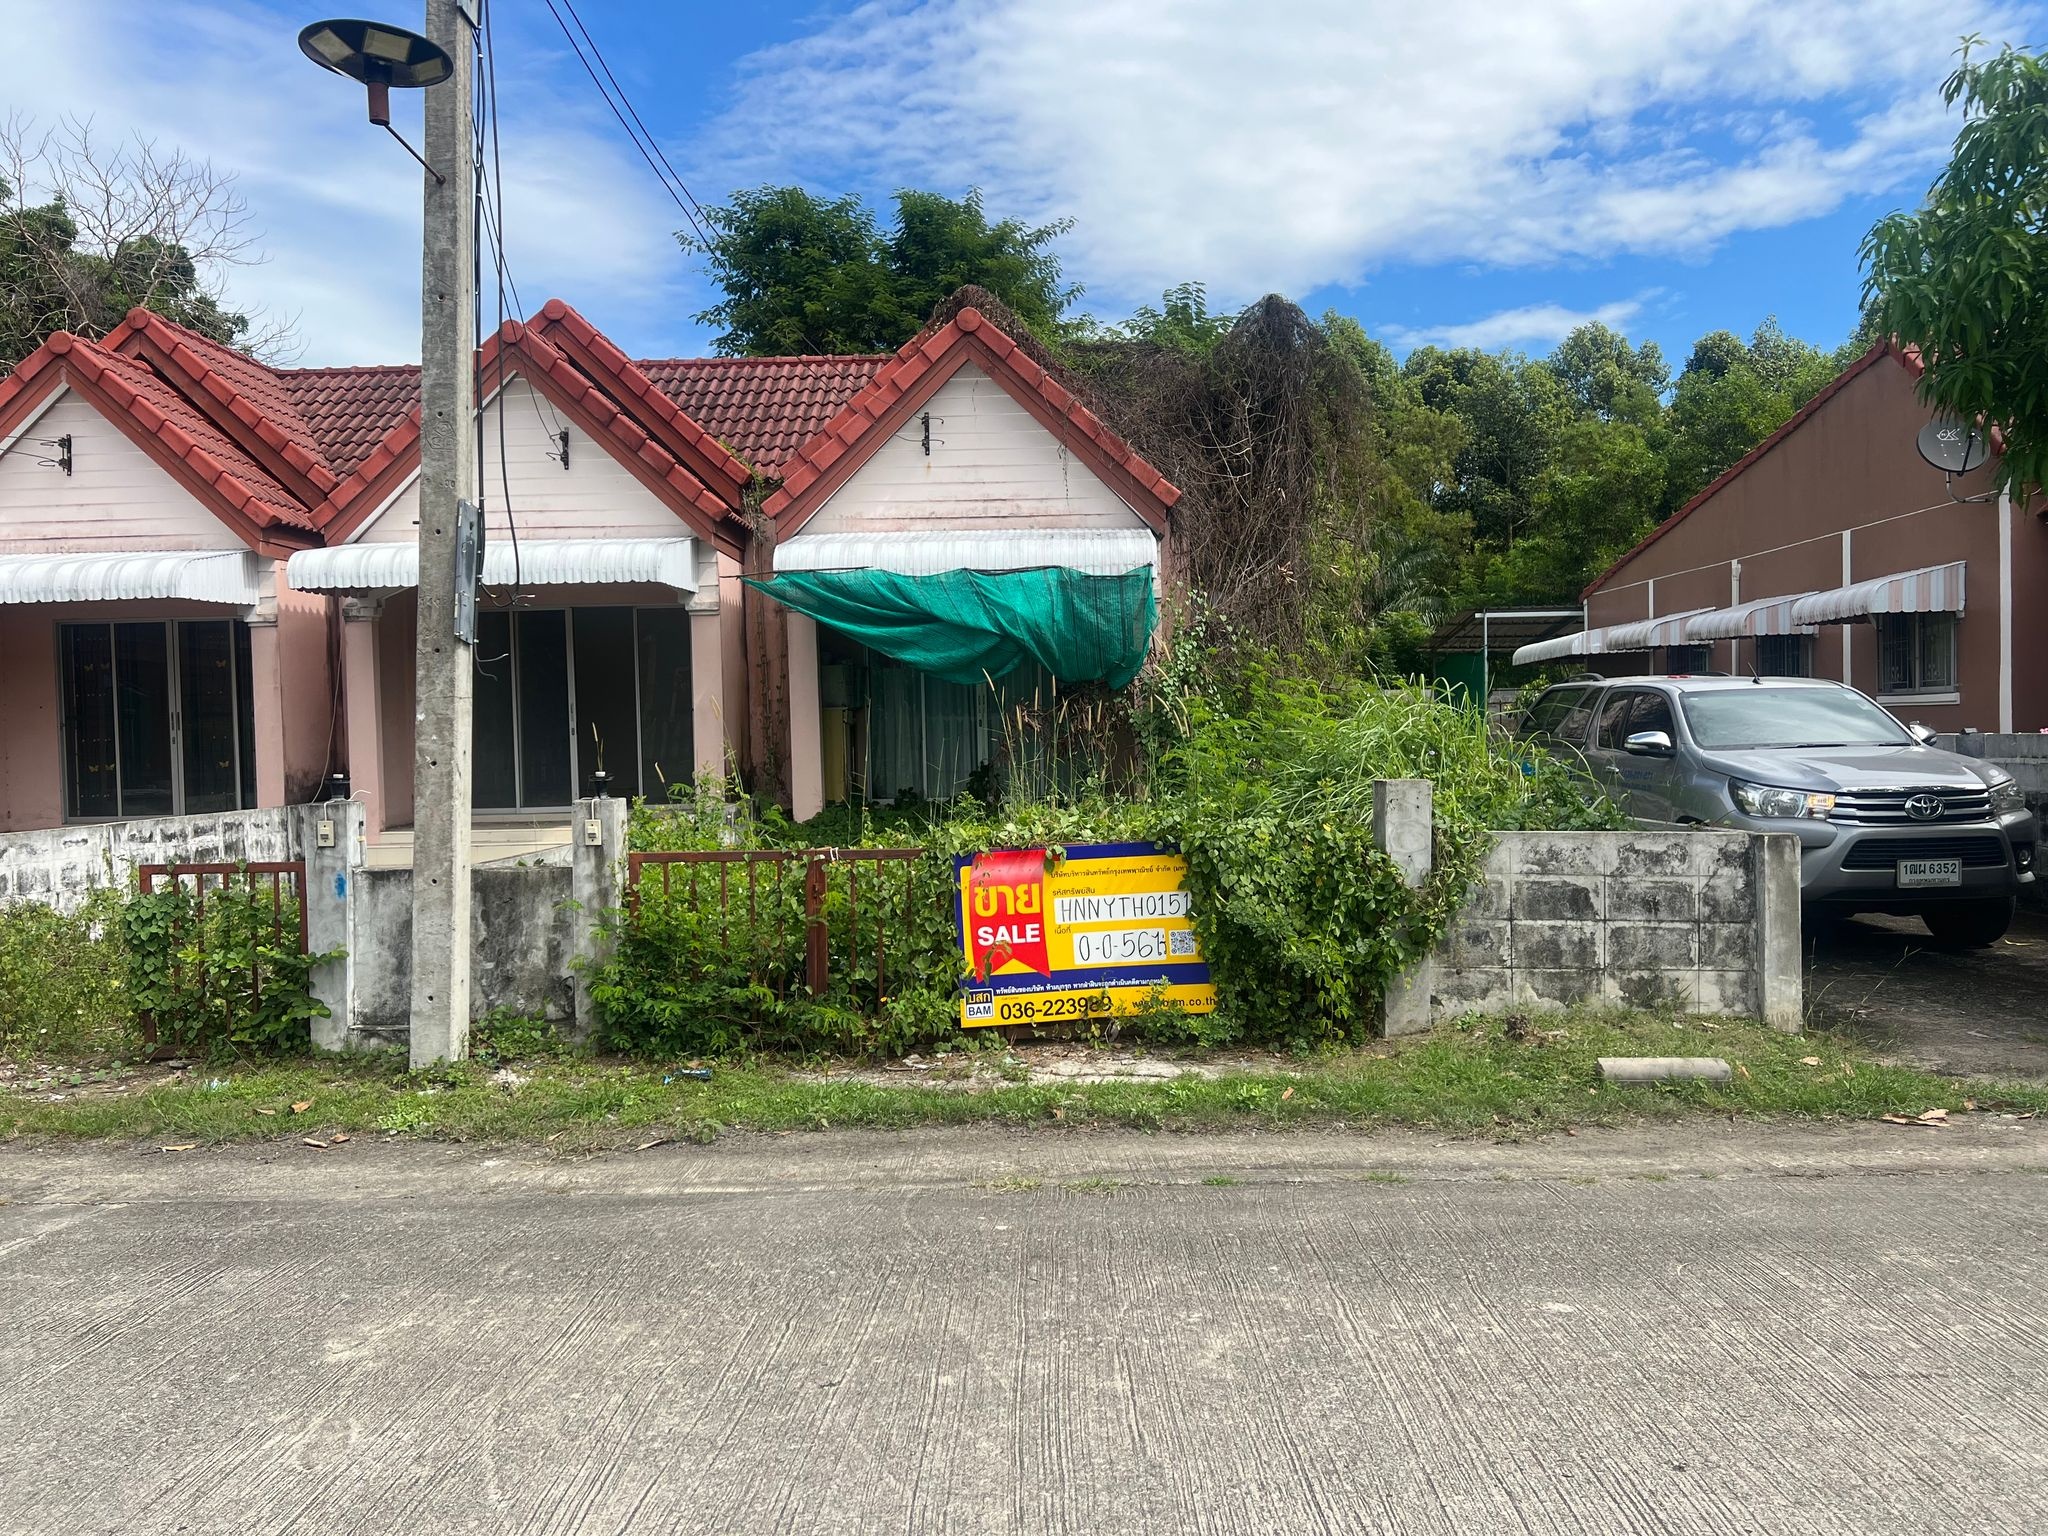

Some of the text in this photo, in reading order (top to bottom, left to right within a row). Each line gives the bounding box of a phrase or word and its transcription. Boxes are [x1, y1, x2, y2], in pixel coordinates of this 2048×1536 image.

[1929, 862, 1957, 874] 6352
[974, 883, 1040, 917] ขาย
[1061, 893, 1189, 922] HNNYTH0151
[977, 924, 1040, 946] SALE
[968, 992, 991, 1003] บสก
[969, 1005, 991, 1016] BAM
